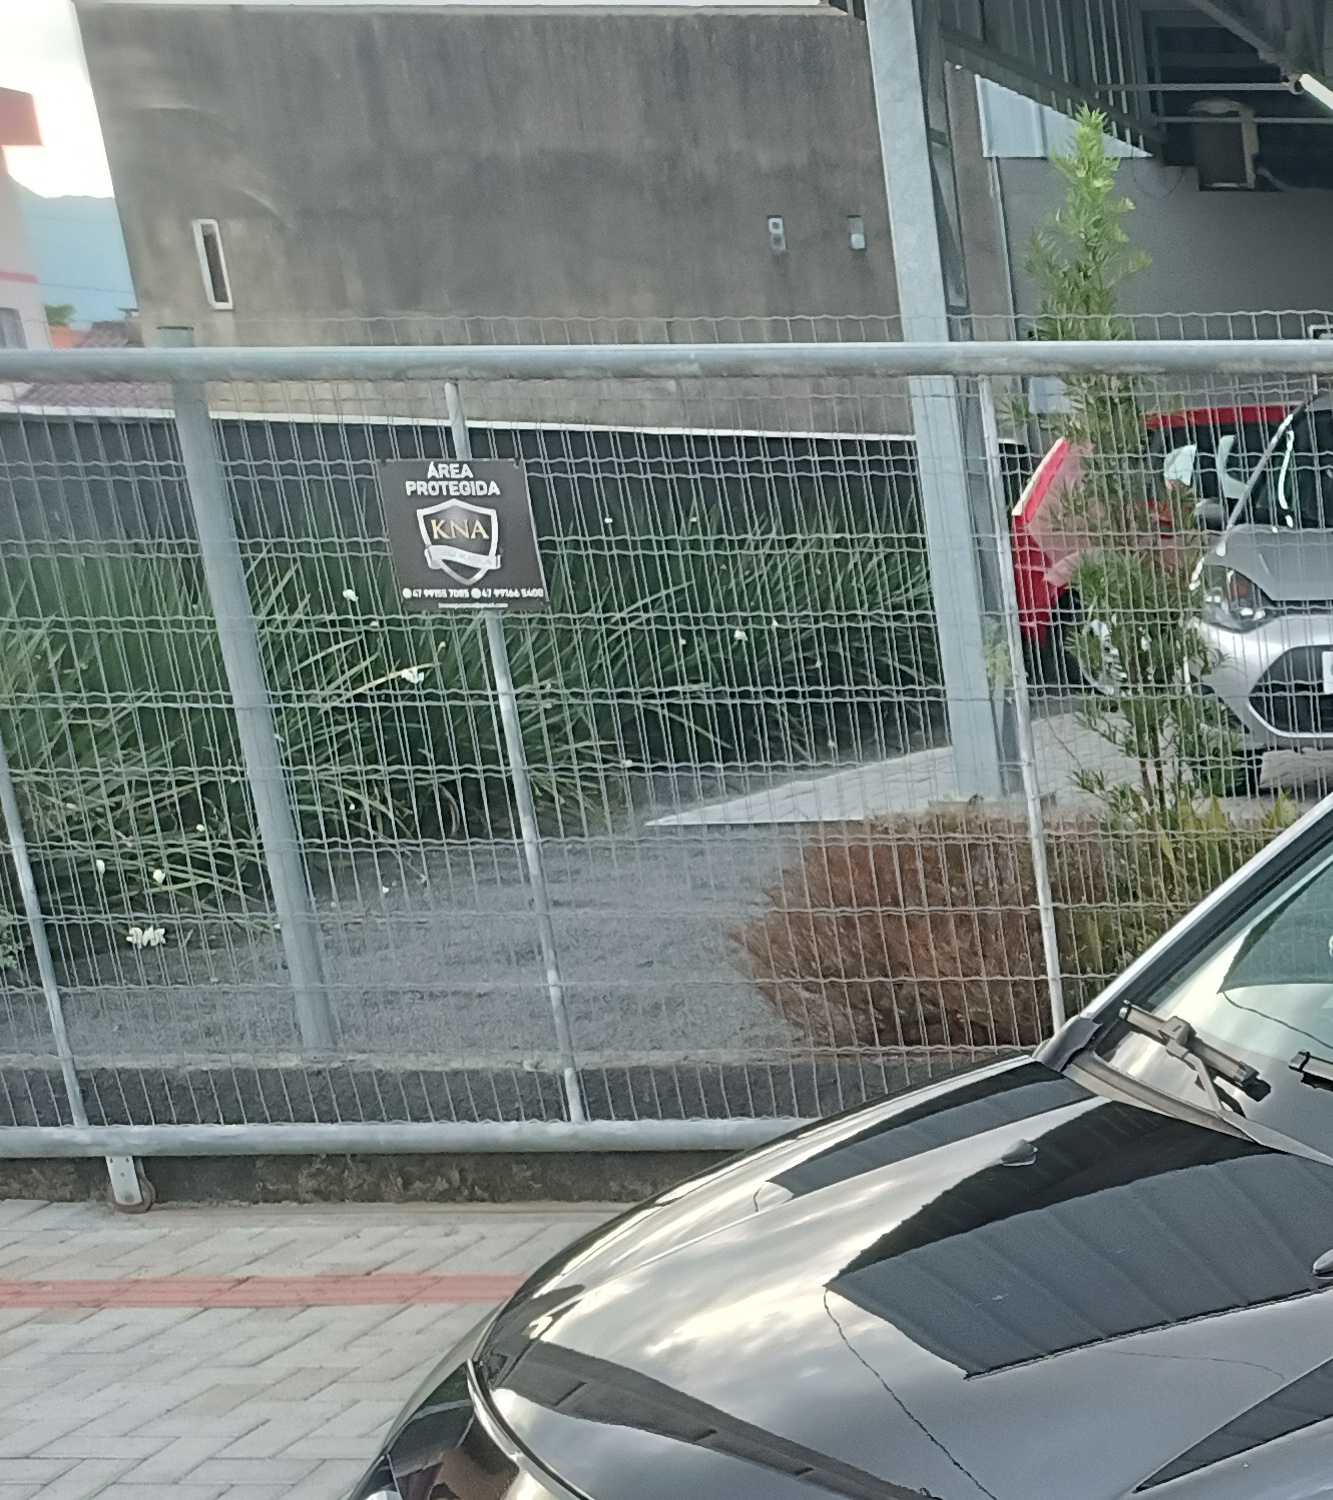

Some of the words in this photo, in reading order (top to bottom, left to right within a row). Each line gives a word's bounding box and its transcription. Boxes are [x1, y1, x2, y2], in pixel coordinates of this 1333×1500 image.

[427, 461, 474, 479] ÁREA
[405, 481, 501, 496] PROTEGIDA
[430, 519, 490, 540] KNA
